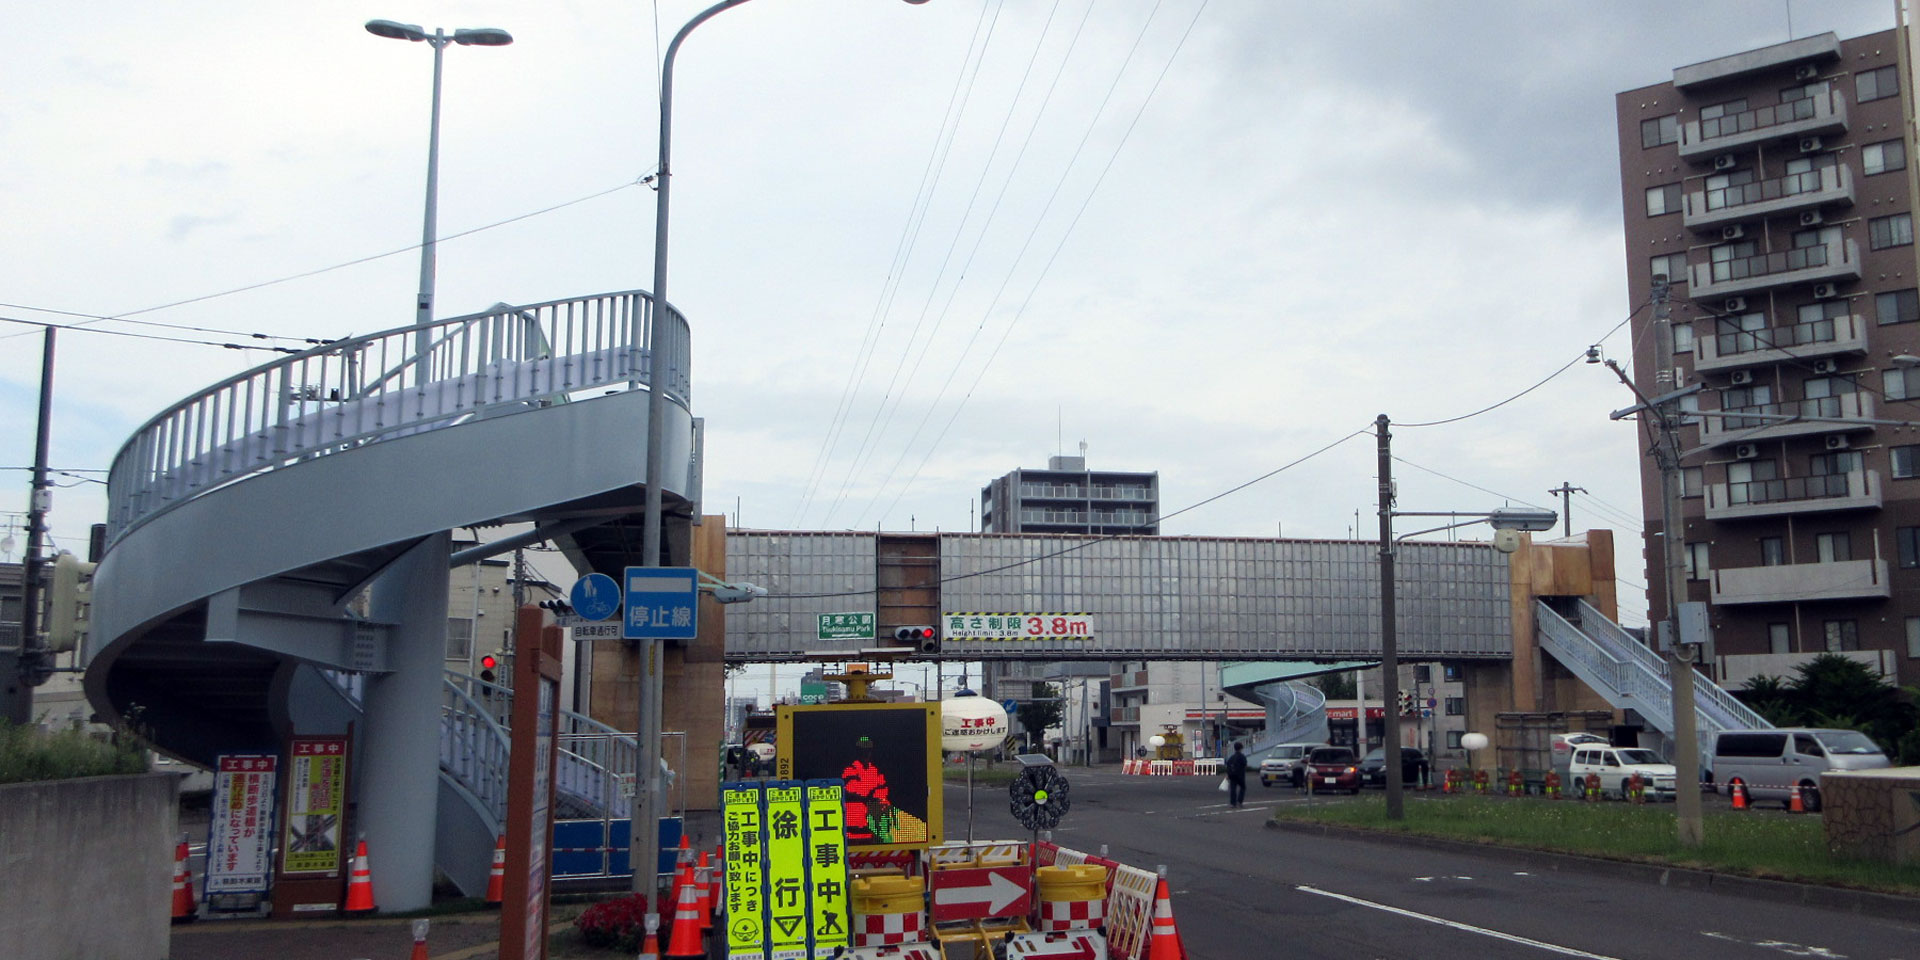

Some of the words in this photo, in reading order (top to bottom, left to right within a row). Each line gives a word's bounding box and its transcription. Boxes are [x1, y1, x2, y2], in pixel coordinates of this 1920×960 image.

[629, 606, 692, 628] 停止線
[822, 614, 872, 625] 月寒公園
[950, 616, 1022, 630] 高さ制限
[575, 625, 618, 637] 自転車通行可
[856, 624, 871, 632] Park
[1027, 617, 1087, 635] 3.8m
[960, 716, 995, 728] 工事中
[944, 727, 1007, 736] ご迷惑おかけします
[299, 743, 340, 754] 工事中
[226, 760, 269, 770] 工事中
[727, 811, 742, 913] ご協力お願い致します
[741, 811, 759, 912] 工事中につき
[772, 809, 801, 908] 徐行
[814, 809, 841, 904] 工事中
